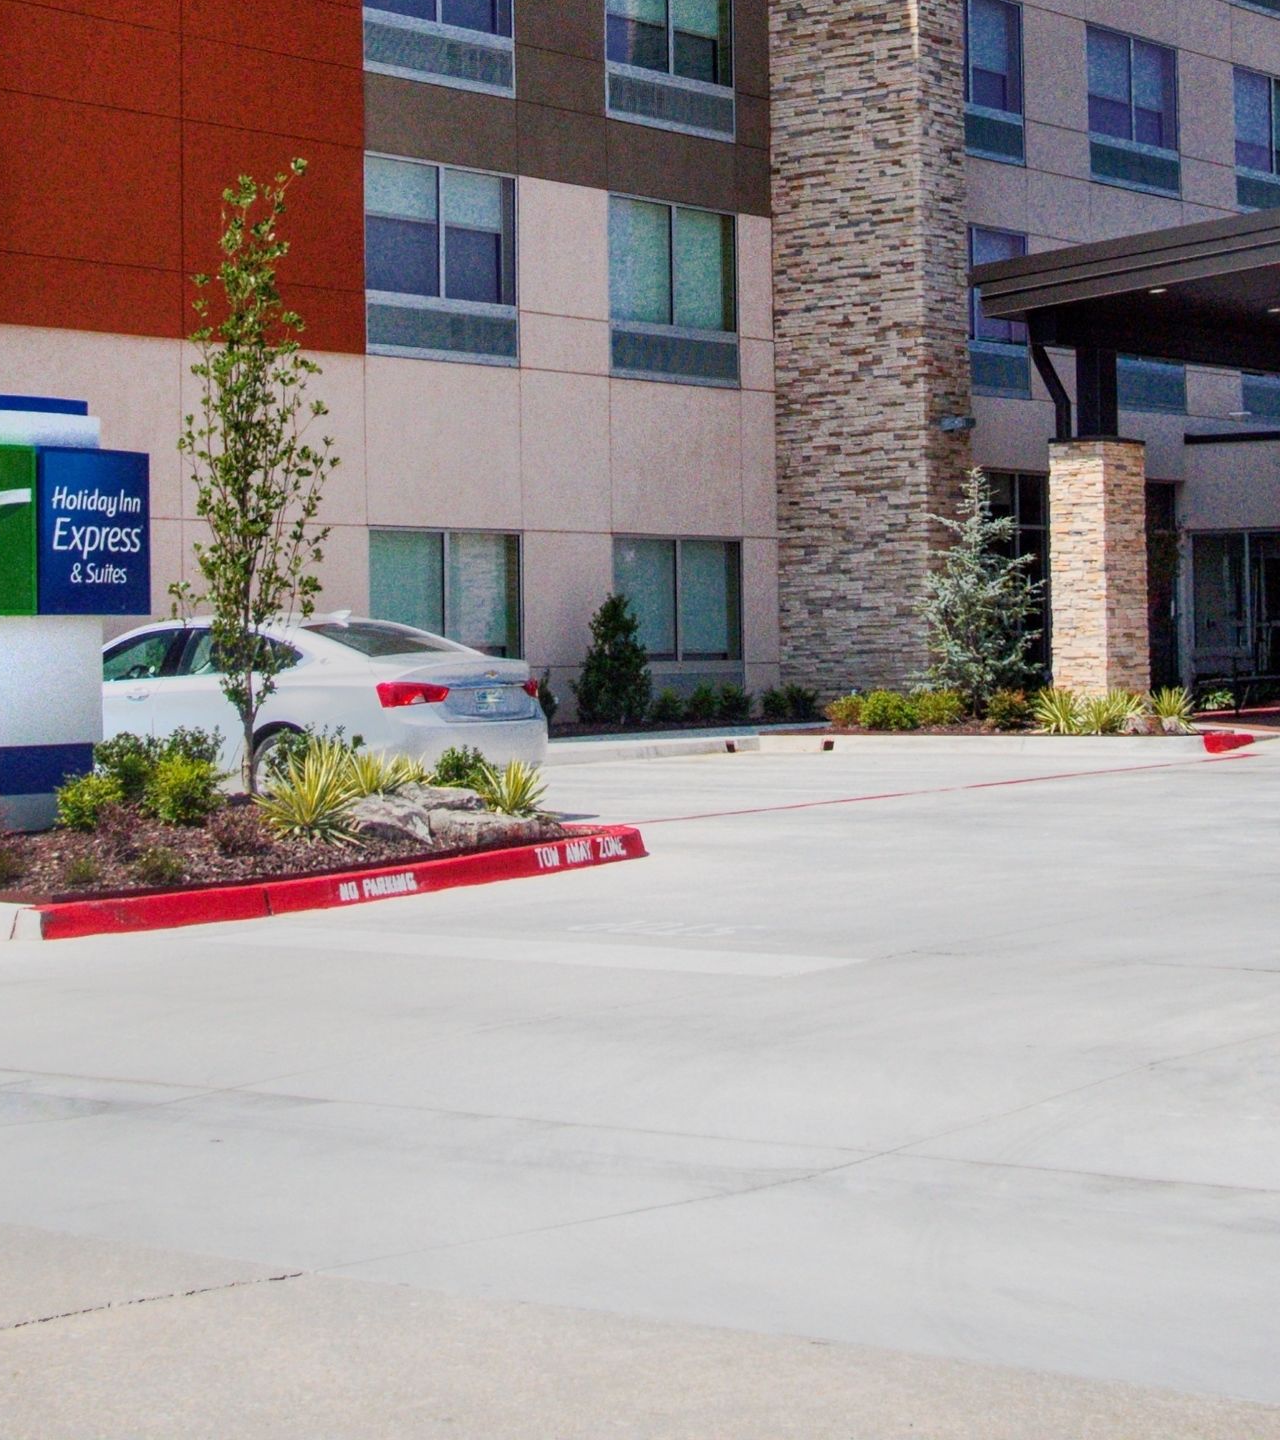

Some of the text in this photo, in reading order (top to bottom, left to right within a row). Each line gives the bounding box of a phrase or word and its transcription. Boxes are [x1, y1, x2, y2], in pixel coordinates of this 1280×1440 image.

[52, 486, 141, 516] Holiday Inn
[52, 518, 141, 559] Express
[70, 563, 127, 584] & Suites
[534, 837, 626, 869] TOW AWAY ZONE
[339, 872, 415, 901] NO PARKING
